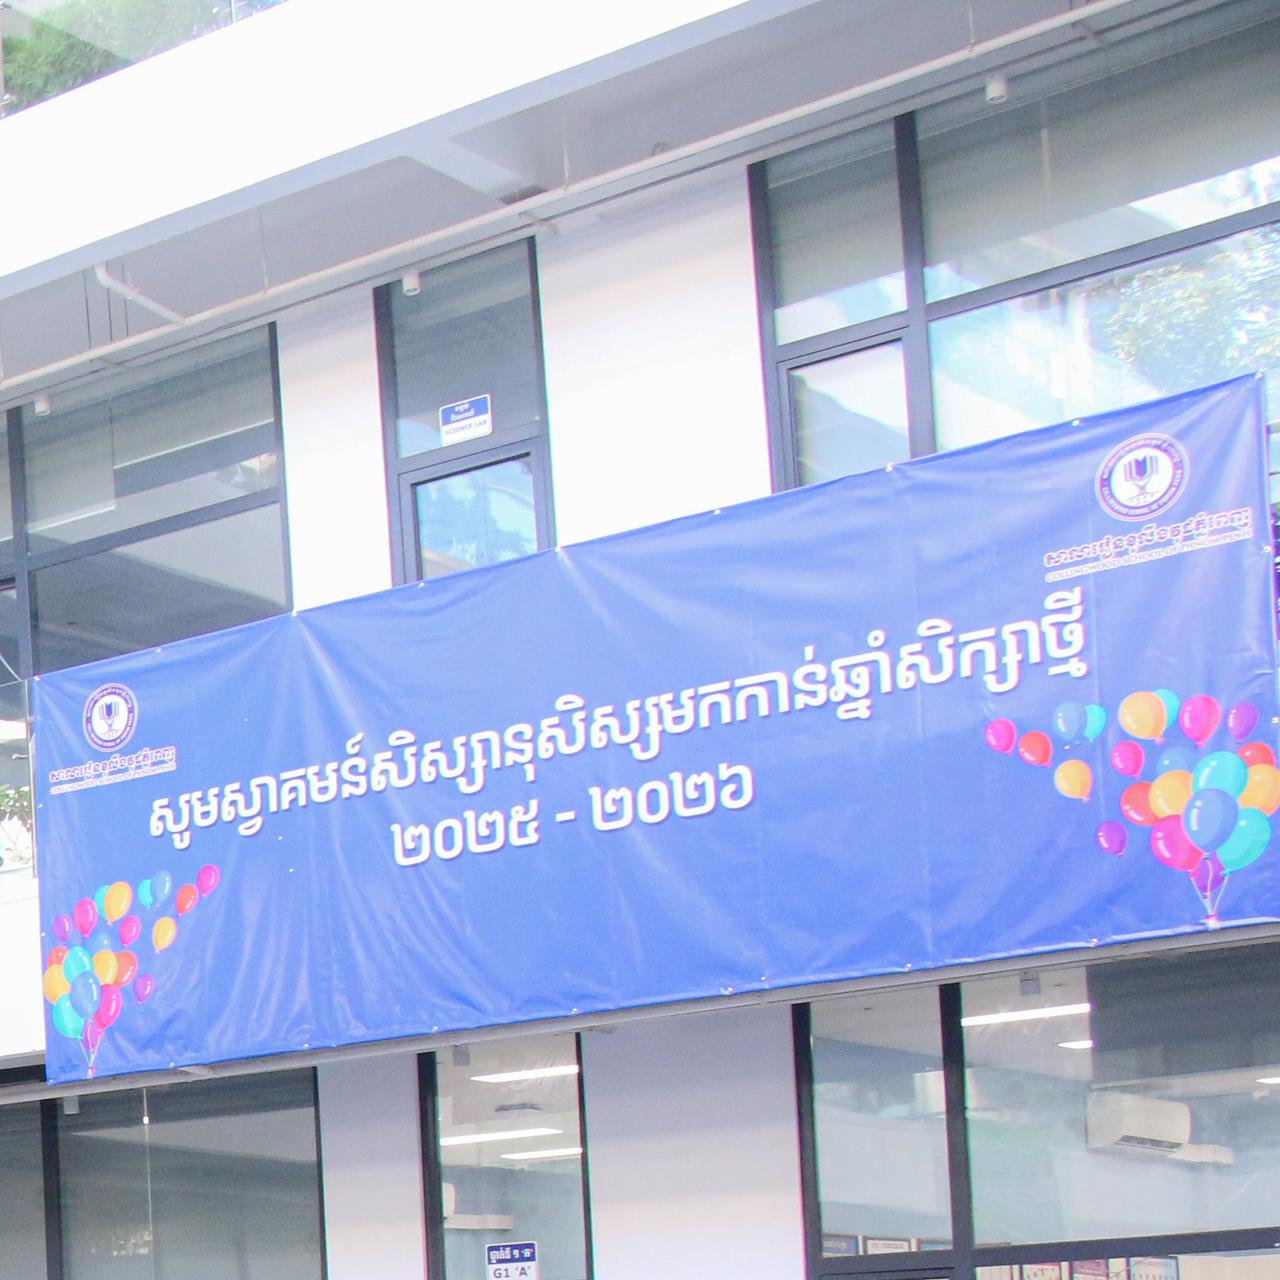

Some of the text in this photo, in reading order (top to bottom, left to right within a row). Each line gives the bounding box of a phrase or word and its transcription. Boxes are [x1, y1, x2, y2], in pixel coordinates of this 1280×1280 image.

[390, 799, 539, 867] ២០២៥
[588, 762, 755, 832] ២០២៦
[493, 1267, 511, 1279] G1
